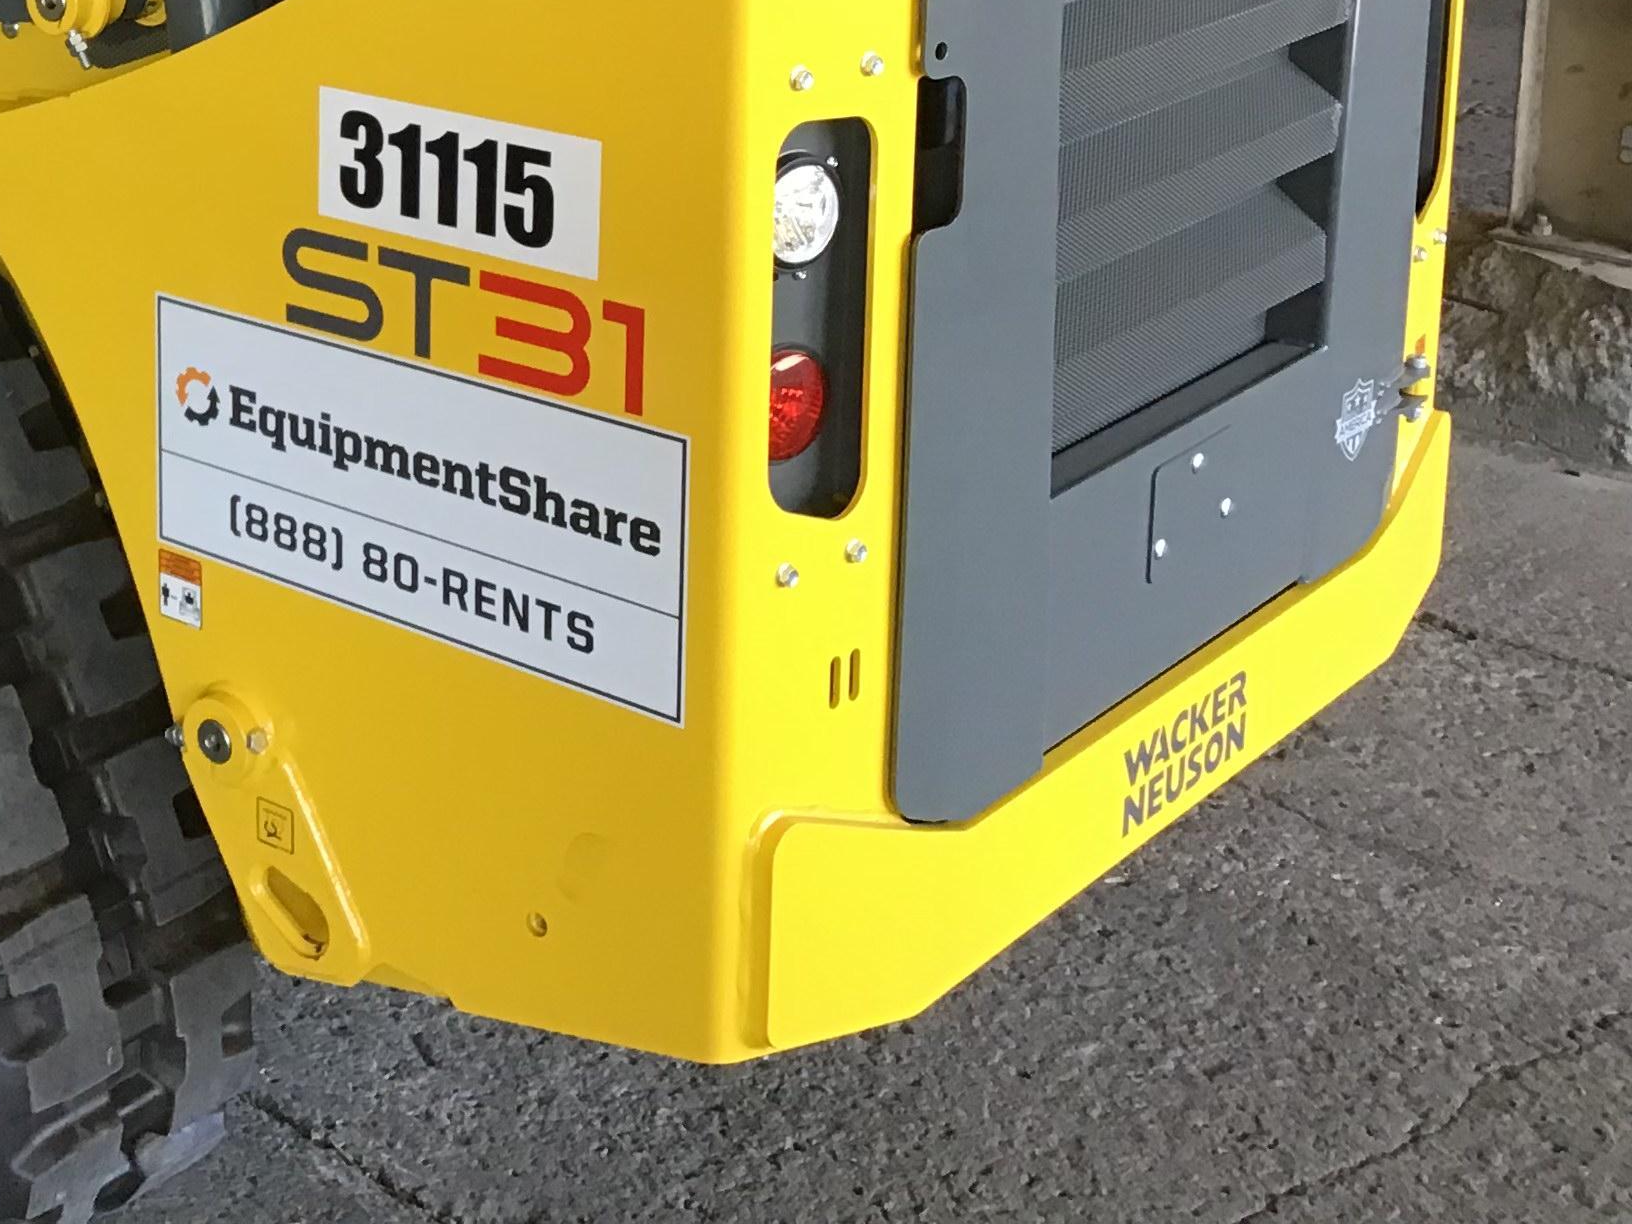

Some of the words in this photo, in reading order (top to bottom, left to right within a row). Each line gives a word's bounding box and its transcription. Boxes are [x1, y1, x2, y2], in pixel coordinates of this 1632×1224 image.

[339, 110, 555, 249] 31115
[282, 227, 645, 417] ST31
[229, 384, 661, 558] EquipmentShare
[229, 494, 343, 570] (888)
[362, 542, 595, 654] 80-RENTS
[1121, 710, 1248, 839] NEUSON
[1123, 669, 1248, 788] WACKER
